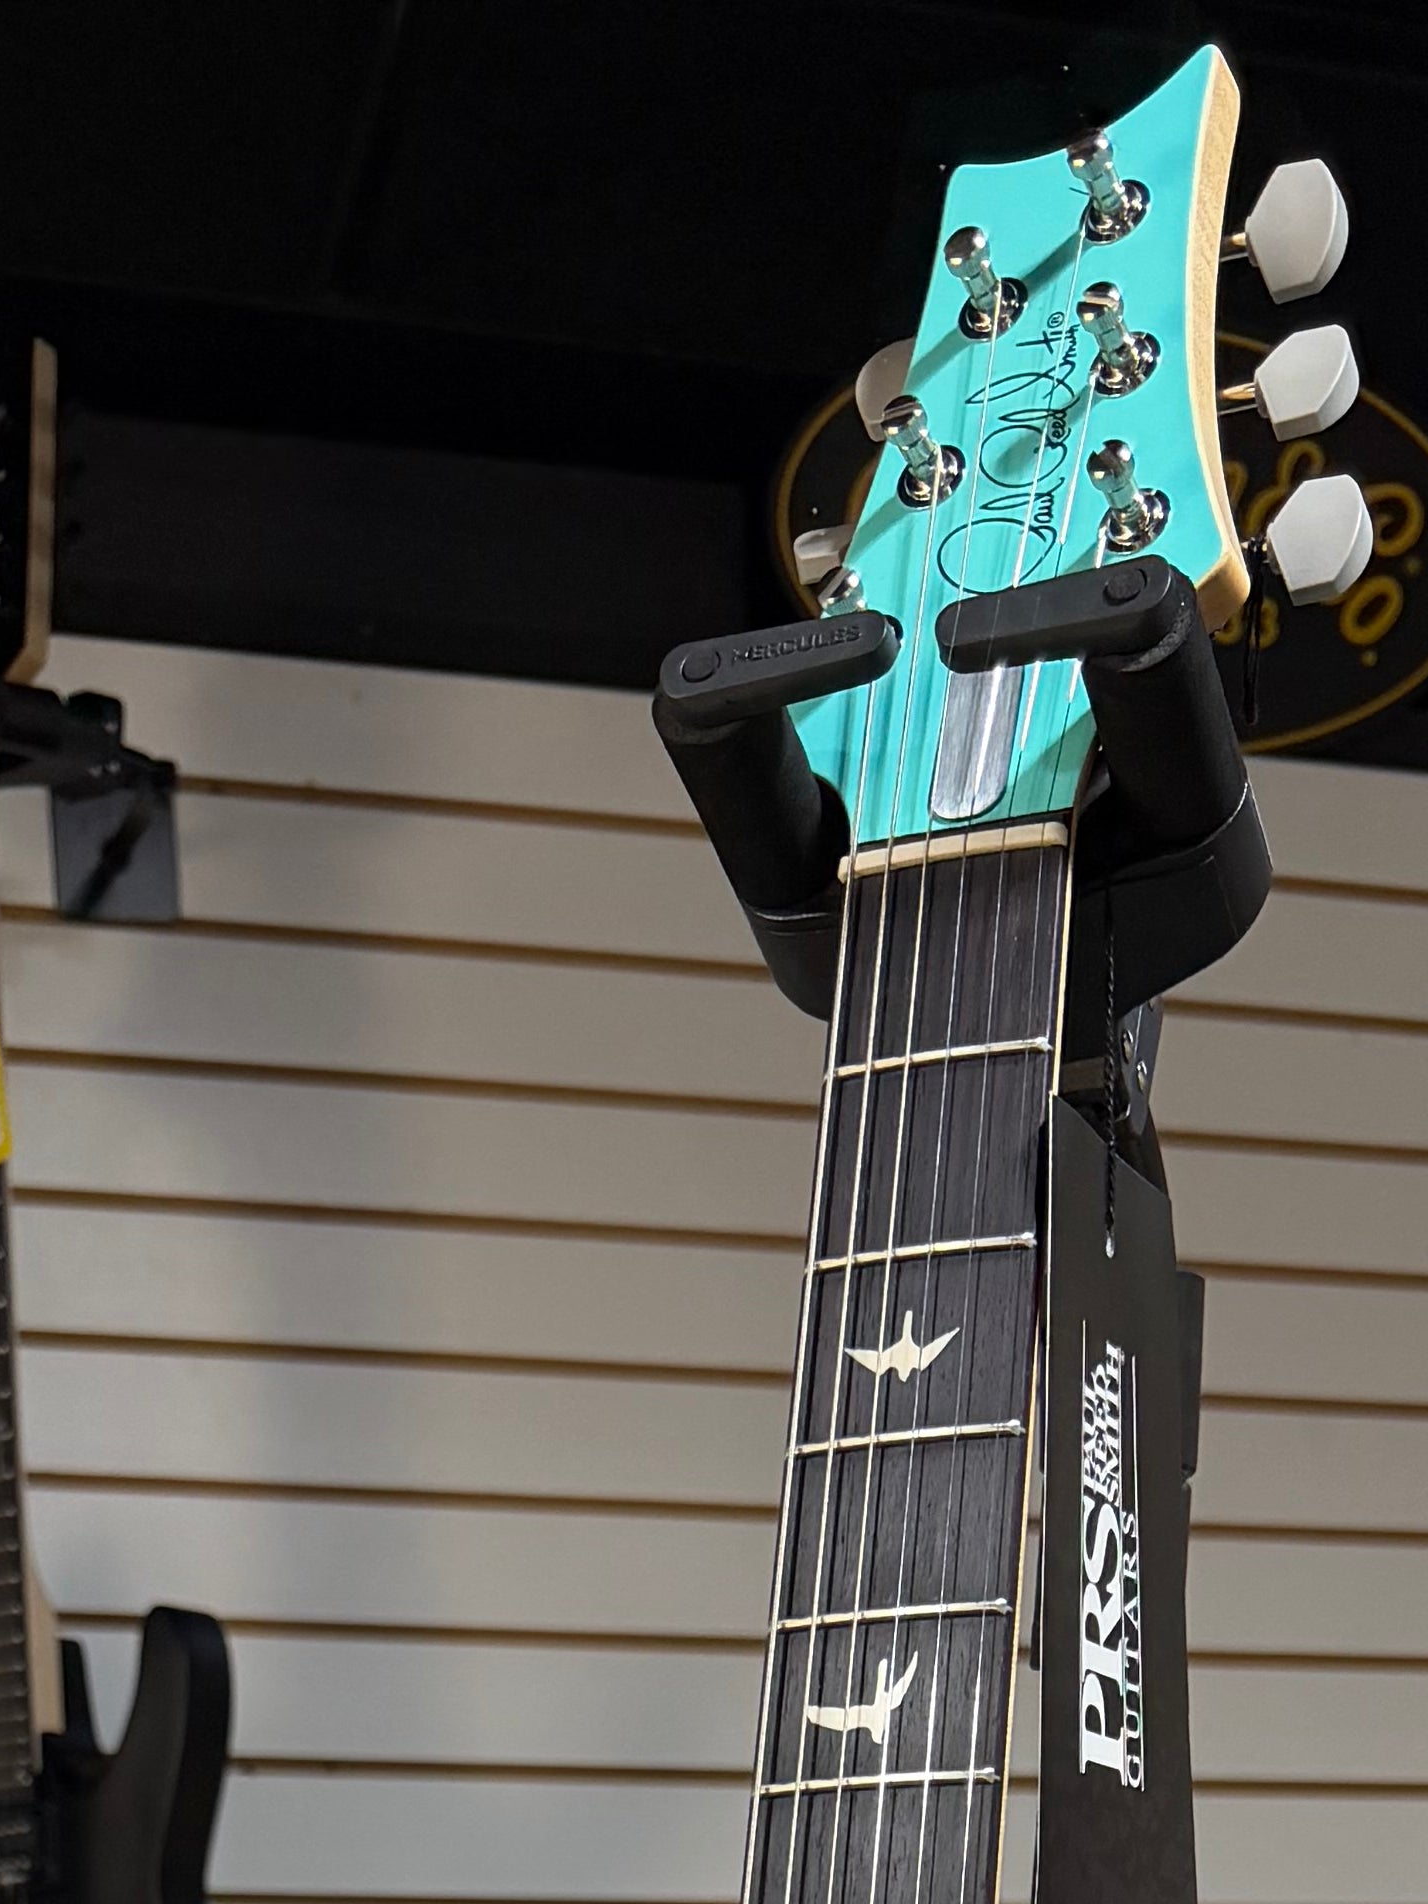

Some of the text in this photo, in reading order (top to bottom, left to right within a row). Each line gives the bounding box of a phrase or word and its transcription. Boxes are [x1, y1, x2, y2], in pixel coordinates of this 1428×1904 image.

[731, 623, 863, 666] HERCULES
[1081, 1497, 1126, 1786] PRS
[1123, 1509, 1144, 1790] GUITARS
